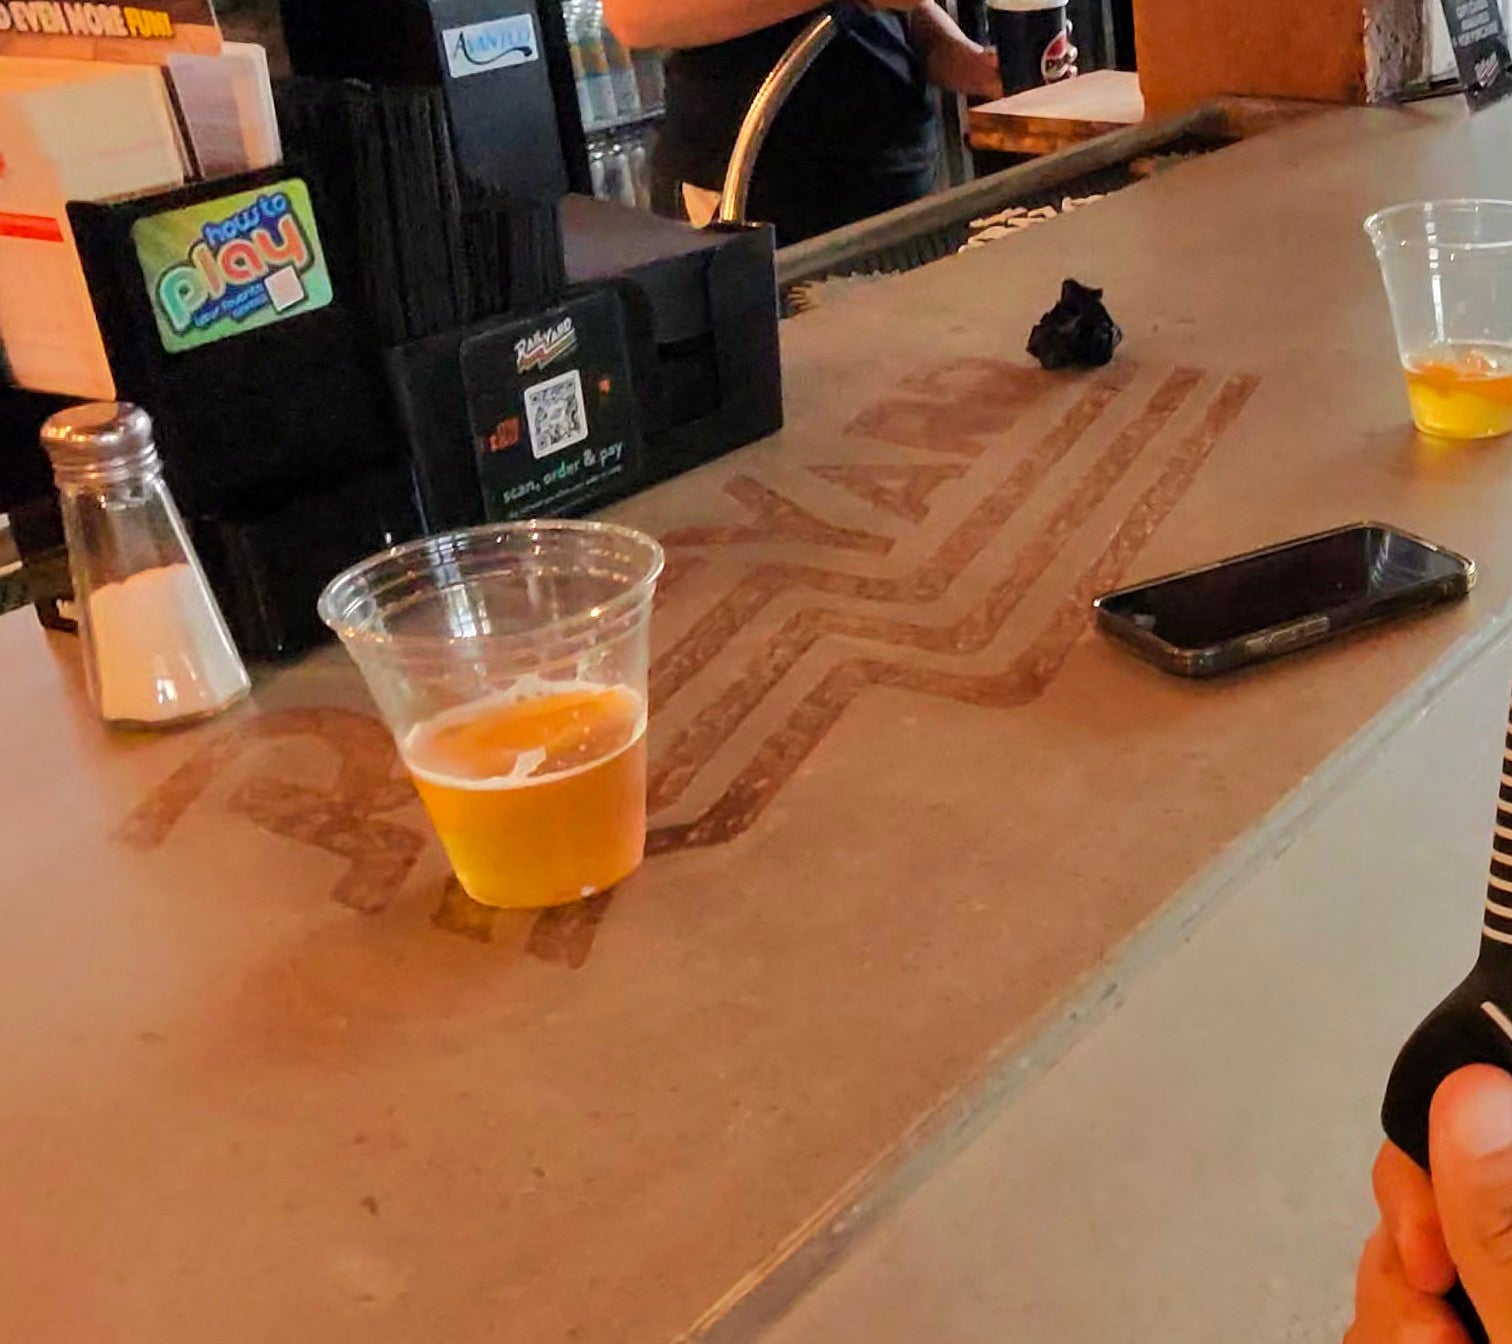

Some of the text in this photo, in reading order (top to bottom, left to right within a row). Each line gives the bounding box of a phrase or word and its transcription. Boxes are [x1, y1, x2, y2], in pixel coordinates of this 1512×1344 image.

[205, 193, 287, 248] how to
[158, 212, 310, 333] play
[543, 460, 580, 485] order
[583, 447, 597, 466] &
[599, 441, 624, 468] pay
